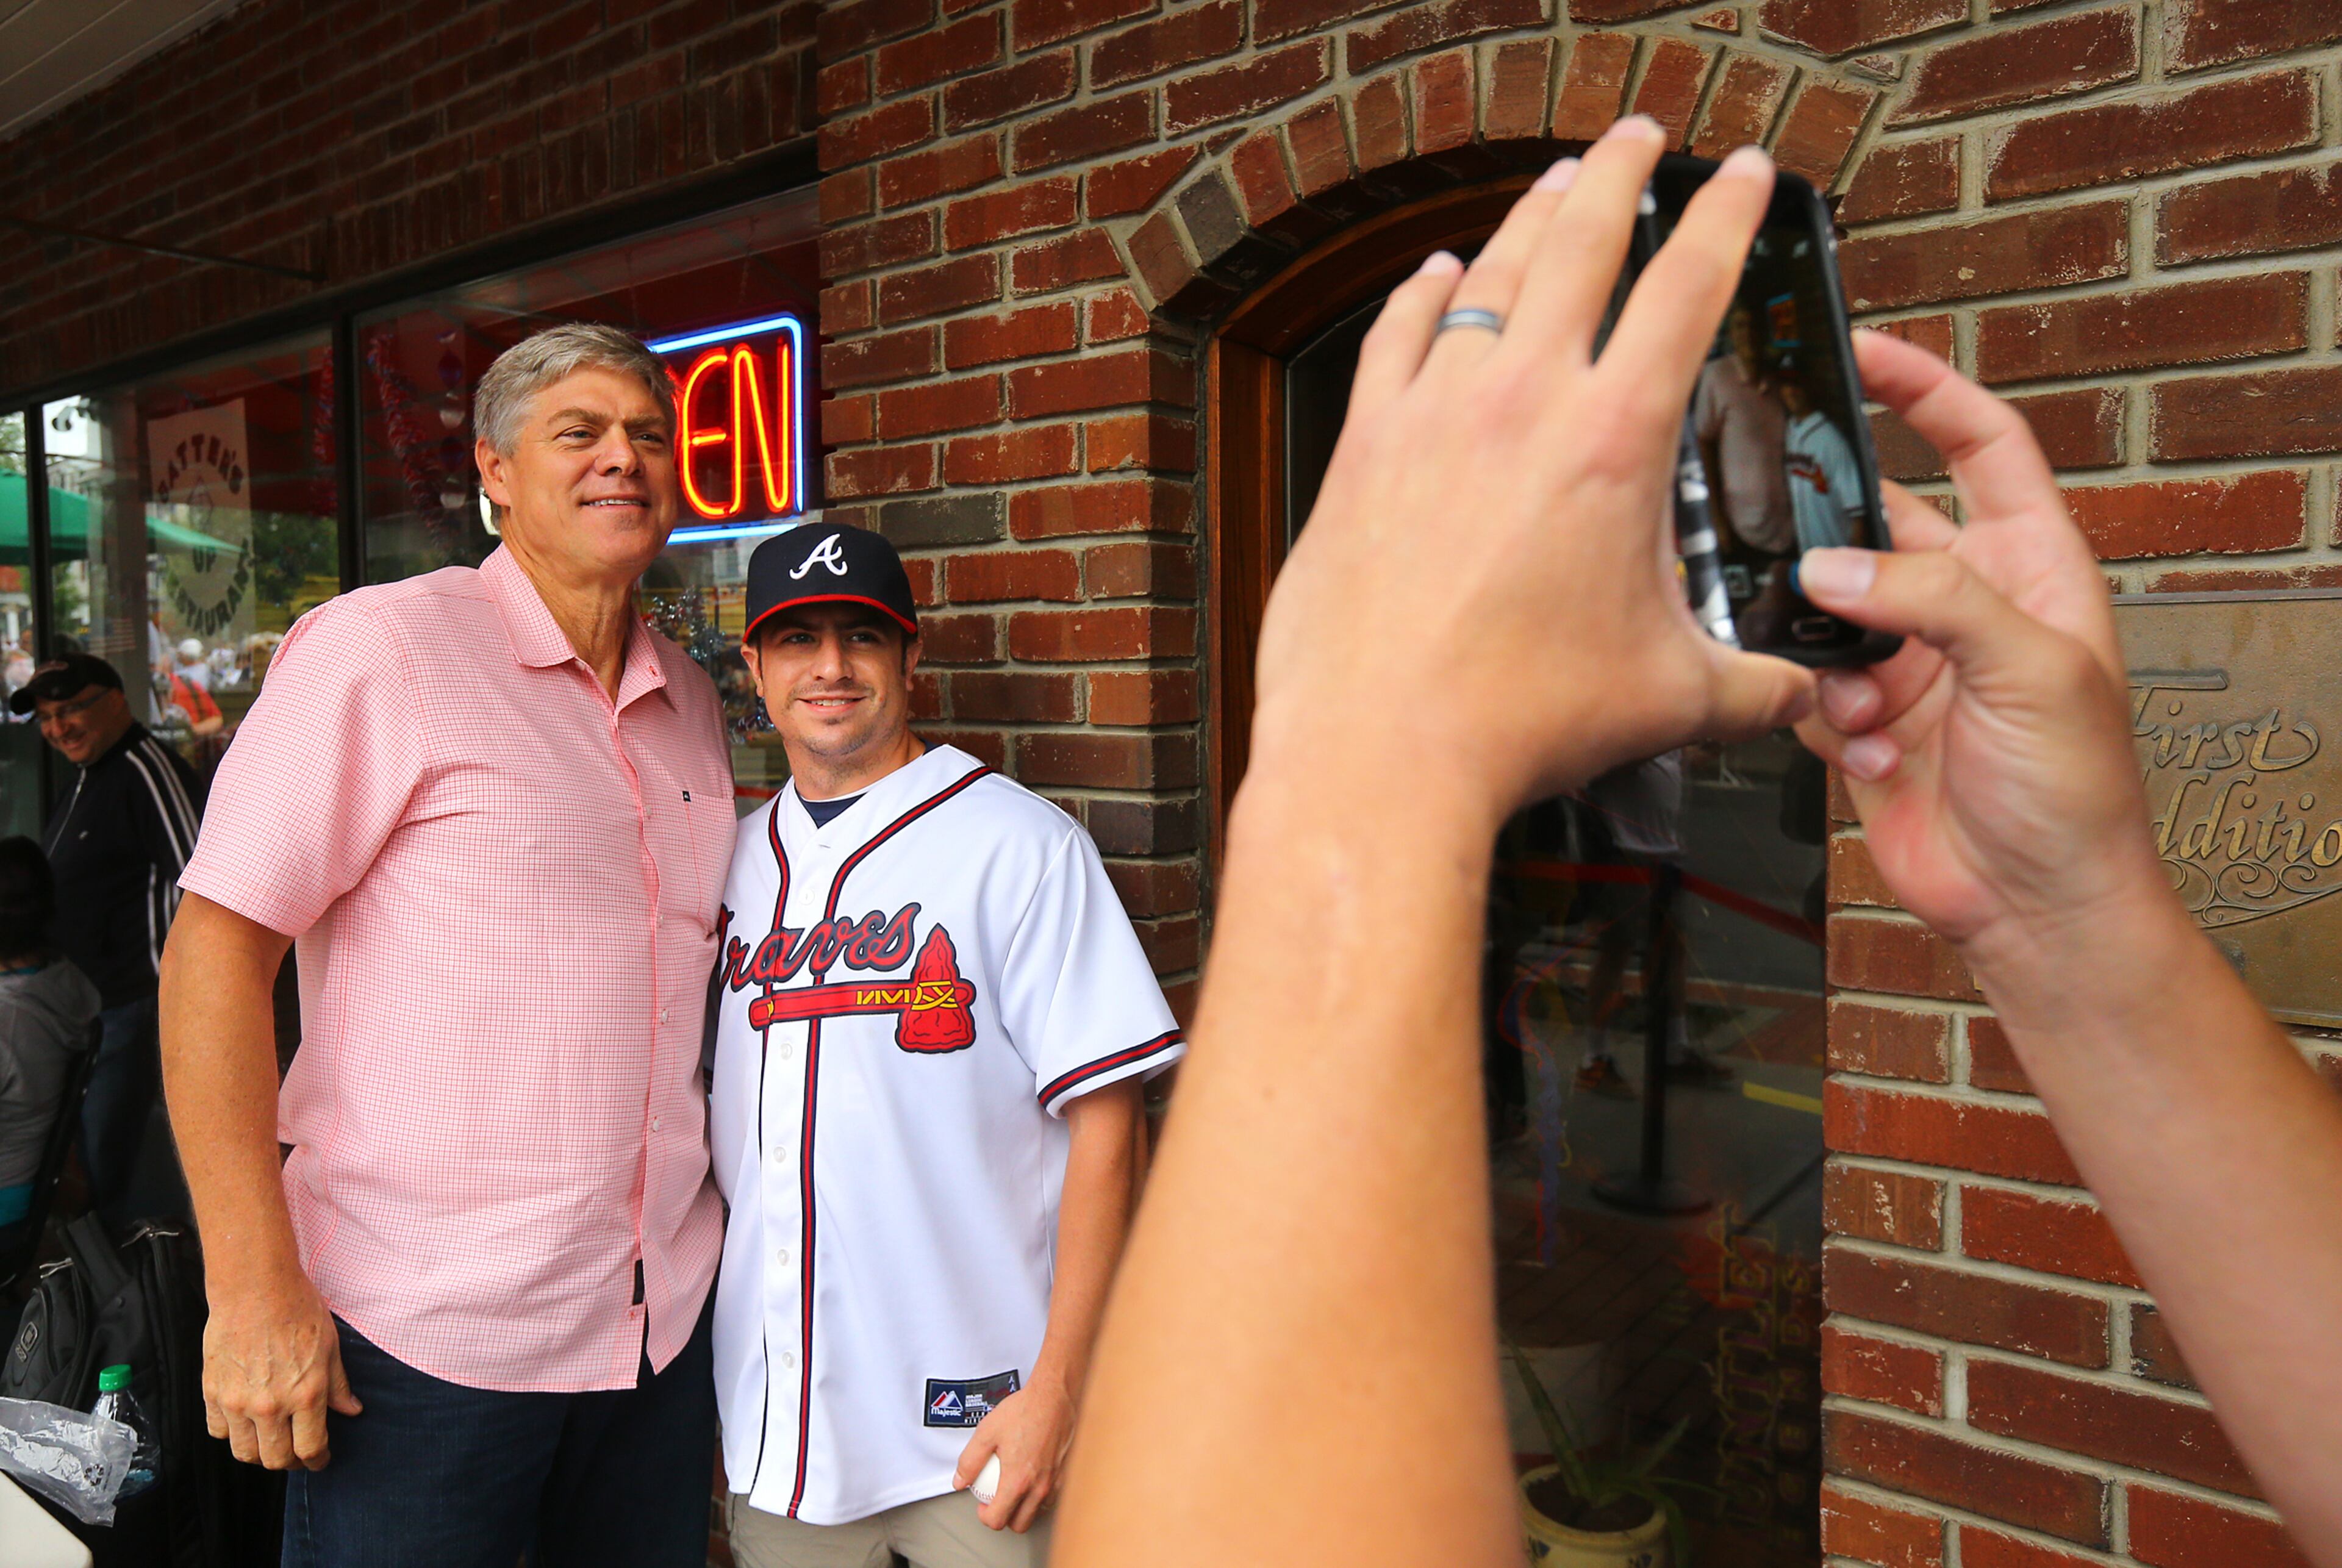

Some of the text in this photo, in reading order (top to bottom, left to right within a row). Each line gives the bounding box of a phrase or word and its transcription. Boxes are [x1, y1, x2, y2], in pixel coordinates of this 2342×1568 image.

[665, 337, 790, 519] EN
[789, 532, 848, 581] A
[2143, 770, 2341, 867] dditio
[715, 902, 922, 993] raves
